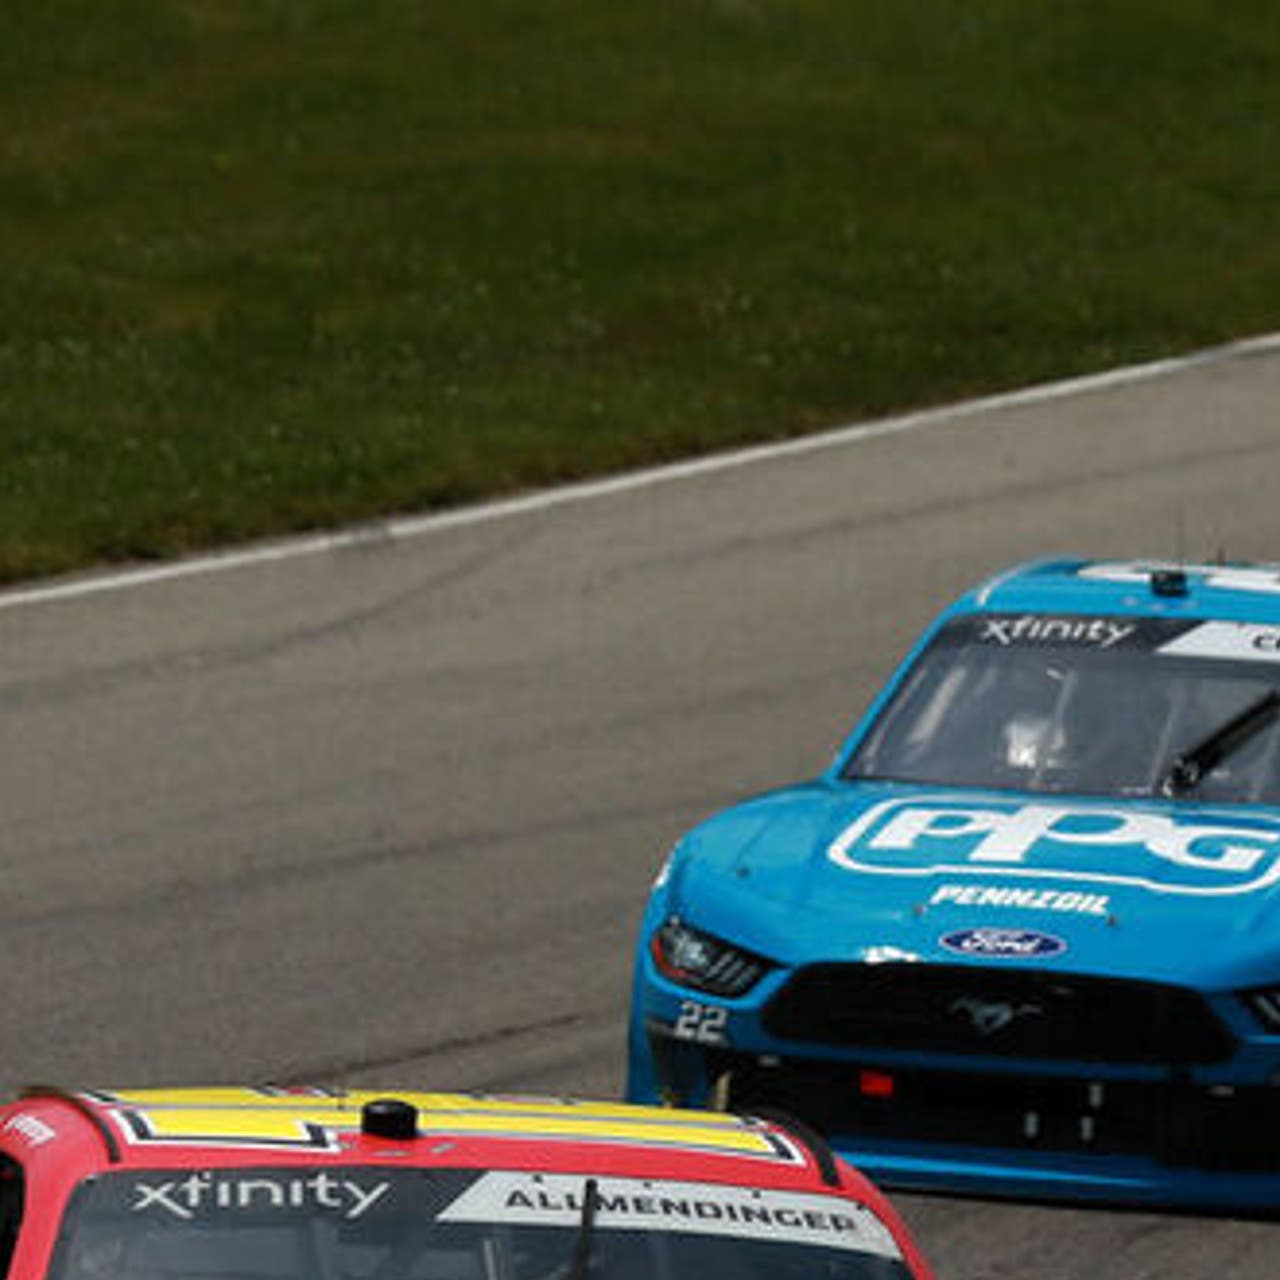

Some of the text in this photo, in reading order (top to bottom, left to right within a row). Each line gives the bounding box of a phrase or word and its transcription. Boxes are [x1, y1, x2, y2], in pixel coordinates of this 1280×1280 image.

[980, 617, 1136, 650] xfinity
[929, 885, 1112, 915] PENNZOIL
[962, 929, 1043, 955] Ford
[674, 1000, 728, 1042] 22
[131, 1171, 392, 1220] xfinity
[504, 1187, 858, 1233] ALLMENDINGER
